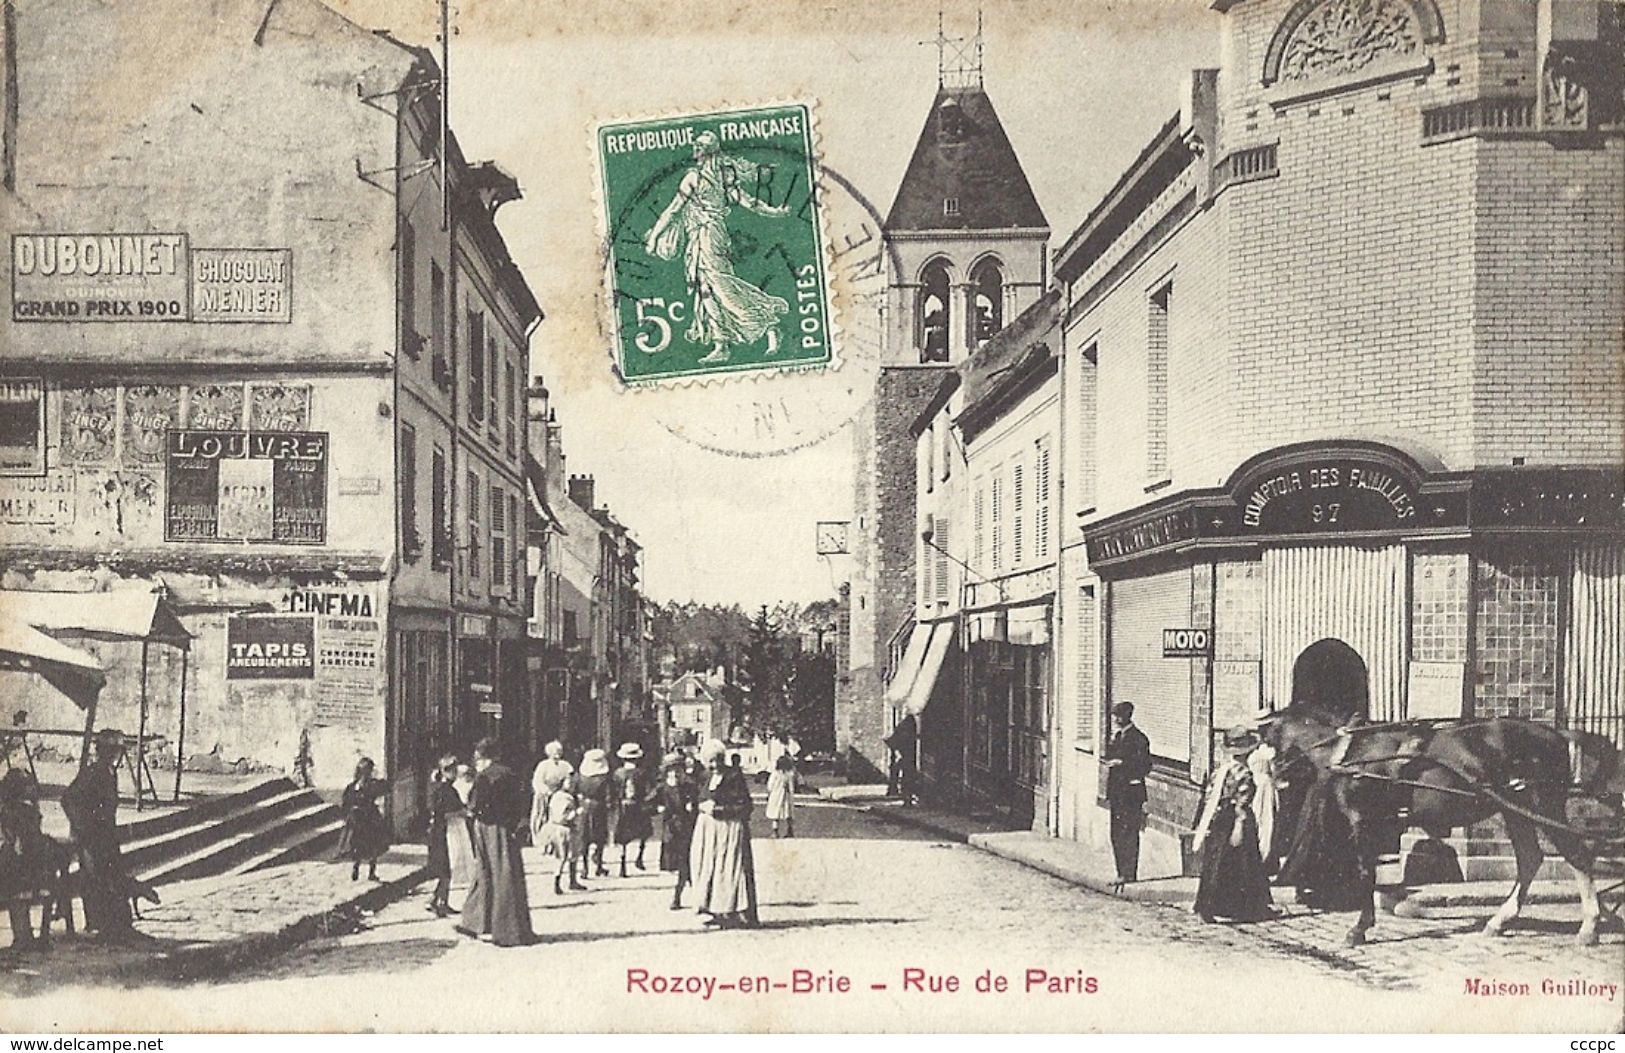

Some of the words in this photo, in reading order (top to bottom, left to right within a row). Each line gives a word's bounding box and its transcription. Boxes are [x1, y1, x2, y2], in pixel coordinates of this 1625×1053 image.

[607, 127, 695, 153] REPUBLIQUE
[720, 116, 801, 141] FRANÇAISE
[15, 236, 182, 276] DUBONNET
[198, 260, 285, 283] CHOCOLAT
[17, 301, 79, 316] GRAND
[86, 301, 135, 316] PRIX
[139, 301, 181, 316] 1900
[201, 288, 281, 313] MENIER
[797, 264, 822, 348] POSTES
[172, 433, 323, 461] LOUVRE
[1243, 472, 1303, 527] COMPTOIR
[1309, 467, 1340, 489] DES
[1349, 468, 1416, 519] FAMILLES
[232, 643, 307, 657] TAPIS
[1164, 630, 1206, 649] MOTO
[229, 658, 311, 667] AMEUBLEMENTS
